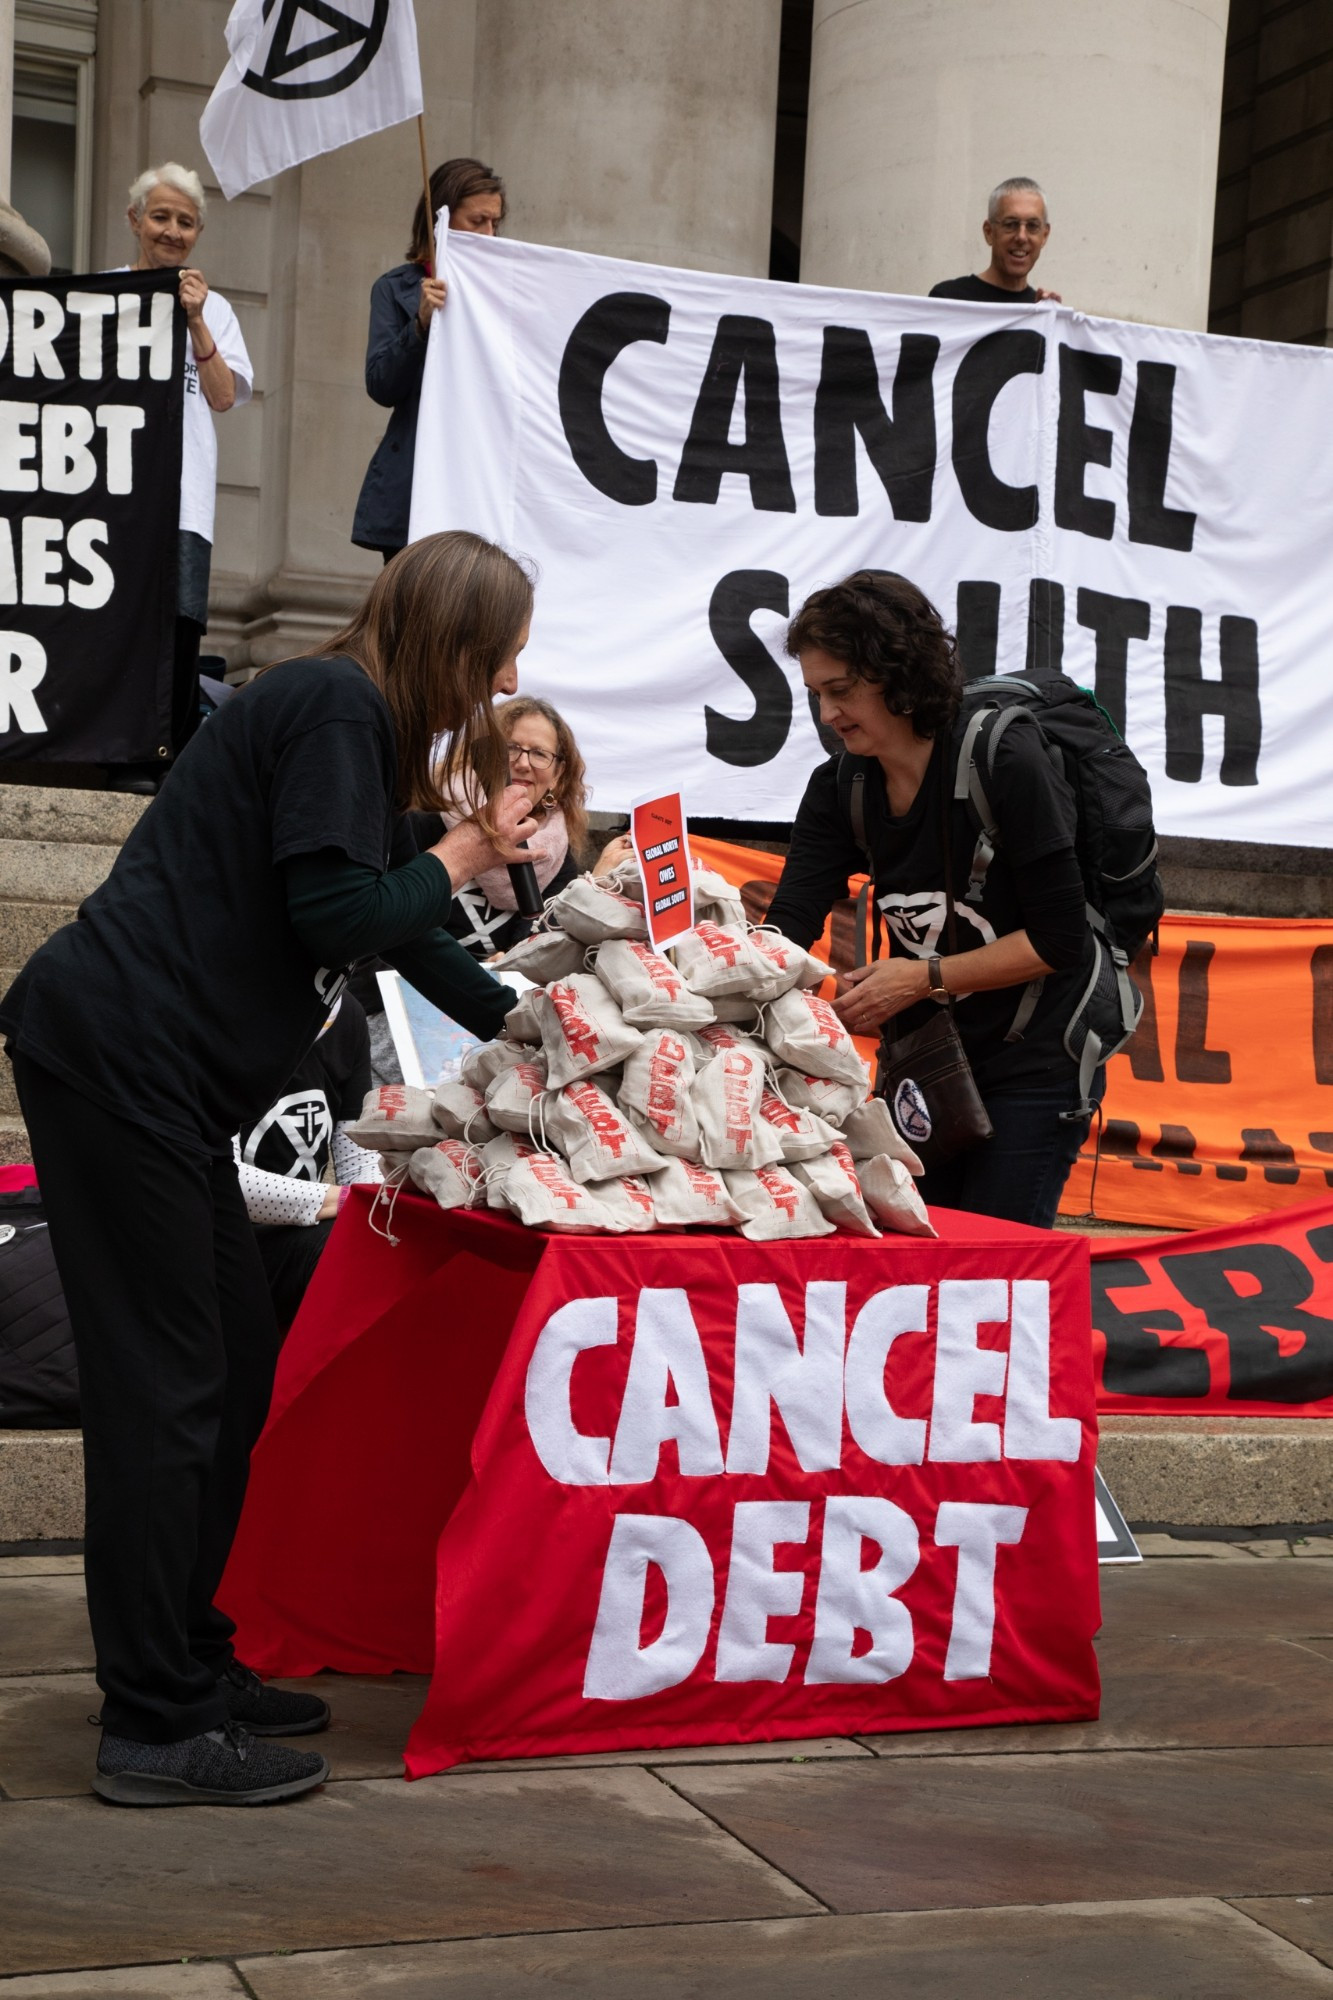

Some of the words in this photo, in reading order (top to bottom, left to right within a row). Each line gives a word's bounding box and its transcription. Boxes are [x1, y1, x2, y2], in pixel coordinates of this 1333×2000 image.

[0, 290, 174, 381] RTH
[0, 400, 145, 495] EBT
[558, 291, 1197, 552] CANCEL
[704, 568, 1261, 787] STH
[645, 844, 663, 861] GLOBAL
[662, 838, 679, 855] NORTH
[659, 866, 675, 883] OWES
[655, 897, 672, 912] GLOBAL
[671, 889, 686, 905] SOUTH
[627, 939, 682, 1003] EBT
[550, 983, 600, 1064] DEBT
[563, 1080, 626, 1158] DEBT
[647, 1035, 686, 1137] DEBT
[723, 1052, 753, 1154] DEBT
[527, 1153, 582, 1209] DEBT
[1091, 1224, 1333, 1404] EB
[525, 1279, 1082, 1486] CANCEL
[582, 1496, 1029, 1699] DEBT
